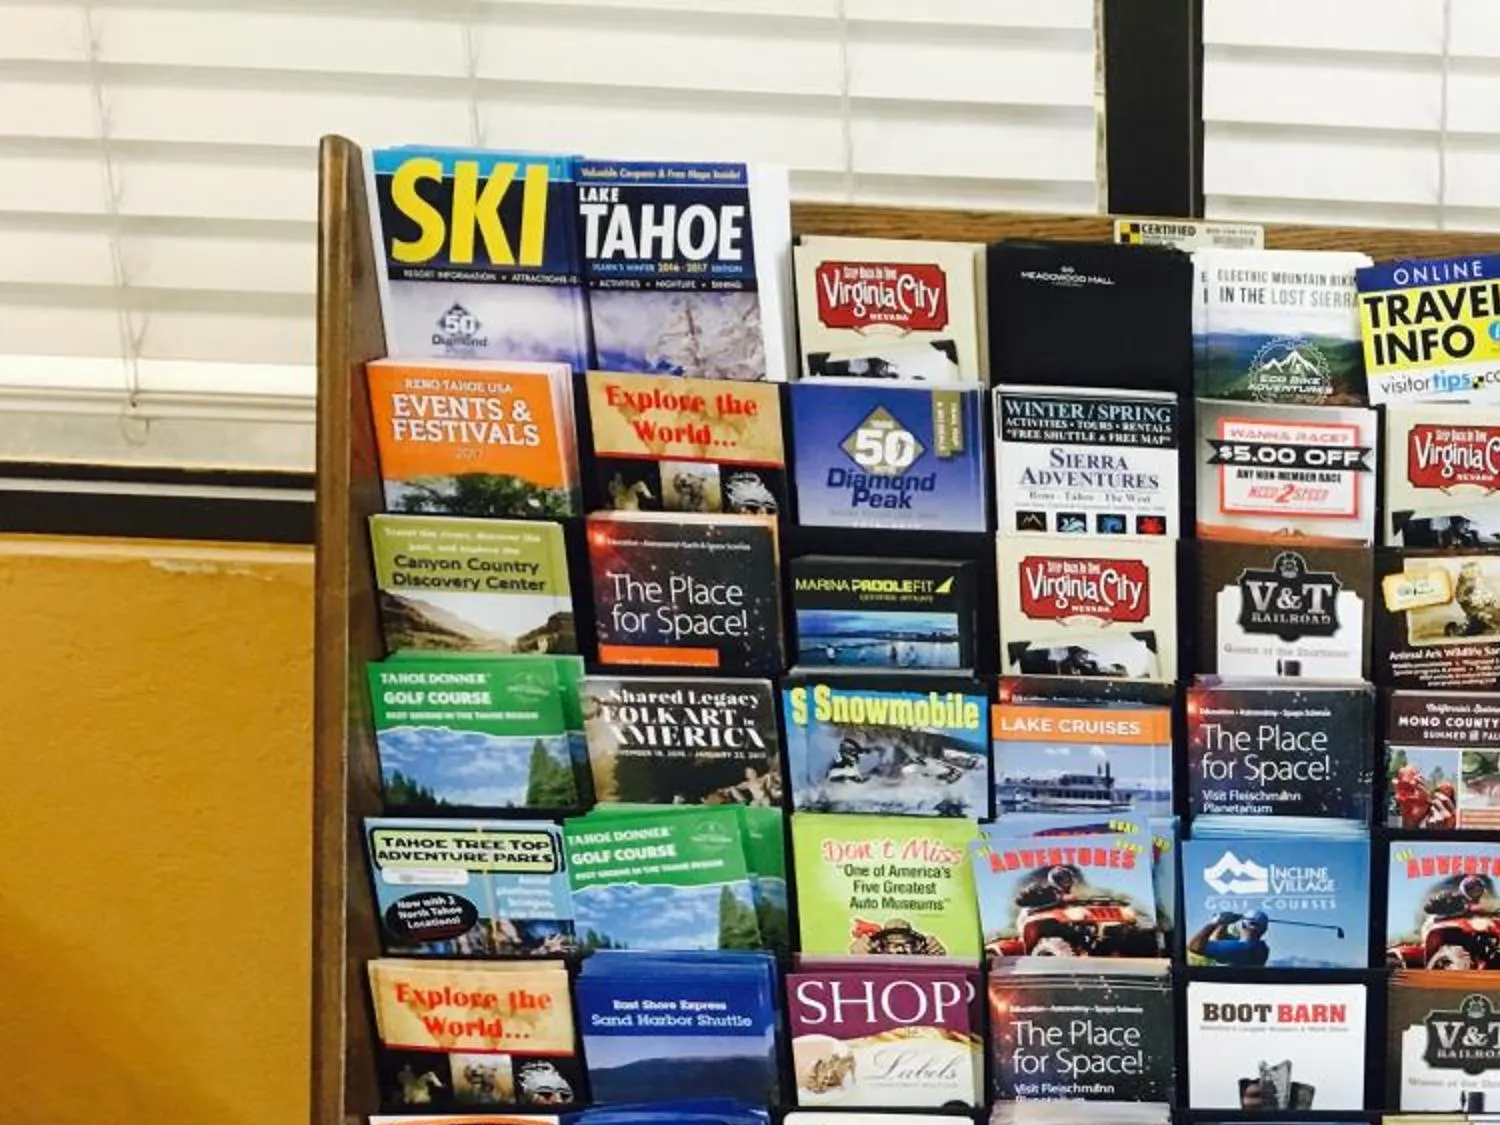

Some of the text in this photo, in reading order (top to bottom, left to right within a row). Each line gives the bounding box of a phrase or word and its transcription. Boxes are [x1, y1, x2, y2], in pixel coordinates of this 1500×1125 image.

[579, 187, 619, 202] LAKE
[391, 157, 549, 267] SKI
[579, 205, 744, 260] TAHOE
[1140, 223, 1197, 237] CERTIFIED
[1393, 260, 1483, 285] ONLINE
[821, 269, 941, 318] Virginia City
[1219, 288, 1236, 303] IN
[1240, 289, 1266, 304] THE
[1271, 291, 1305, 305] LOST
[1374, 324, 1475, 366] INFO
[393, 395, 532, 422] EVENTS &
[605, 384, 758, 417] Explore the
[1004, 403, 1085, 423] WINTER
[1098, 406, 1171, 424] SPRING
[392, 419, 540, 447] FESTIVALS
[1006, 418, 1172, 434] ACTIVITIES TOURS RENTALS
[1049, 447, 1128, 471] SIERRA
[1219, 446, 1361, 466] $5.00 OFF
[1415, 432, 1482, 480] Virginia
[827, 467, 936, 492] Diamond
[1020, 470, 1160, 490] ADVENTURES
[851, 487, 913, 509] Peak
[393, 555, 540, 577] Canyon Country
[392, 573, 546, 593] Discovery Center
[608, 571, 744, 606] The Place
[1026, 564, 1143, 610] Virginia City
[1245, 581, 1333, 612] V&T
[613, 603, 748, 639] for Space!
[1251, 610, 1331, 625] RAILROAD
[380, 672, 486, 685] TAHOE DONNER
[383, 691, 492, 706] GOLF COURSE
[610, 688, 761, 708] Shared Legacy
[814, 684, 980, 730] Snowmobile
[1001, 718, 1141, 736] LAKE CRUISES
[1399, 716, 1441, 728] MONO
[1446, 717, 1499, 729] COUNTY
[1200, 724, 1328, 752] The Place
[1201, 753, 1331, 786] for Space!
[381, 837, 549, 851] TAHOE TREE TOP
[571, 844, 677, 866] GOLF COURSE
[989, 846, 1136, 873] ADVENTURES
[1270, 864, 1329, 880] INCLINE
[853, 880, 936, 895] Five Greatest
[1270, 879, 1335, 894] VILLAGE
[394, 982, 551, 1013] Explore the
[798, 980, 962, 1024] SHOP
[592, 1014, 753, 1027] Sand Harbor Shuttle
[1202, 1003, 1347, 1023] BOOT BARN
[1012, 1020, 1141, 1047] The Place
[866, 1048, 958, 1081] Labels
[1012, 1050, 1144, 1077] for Space!
